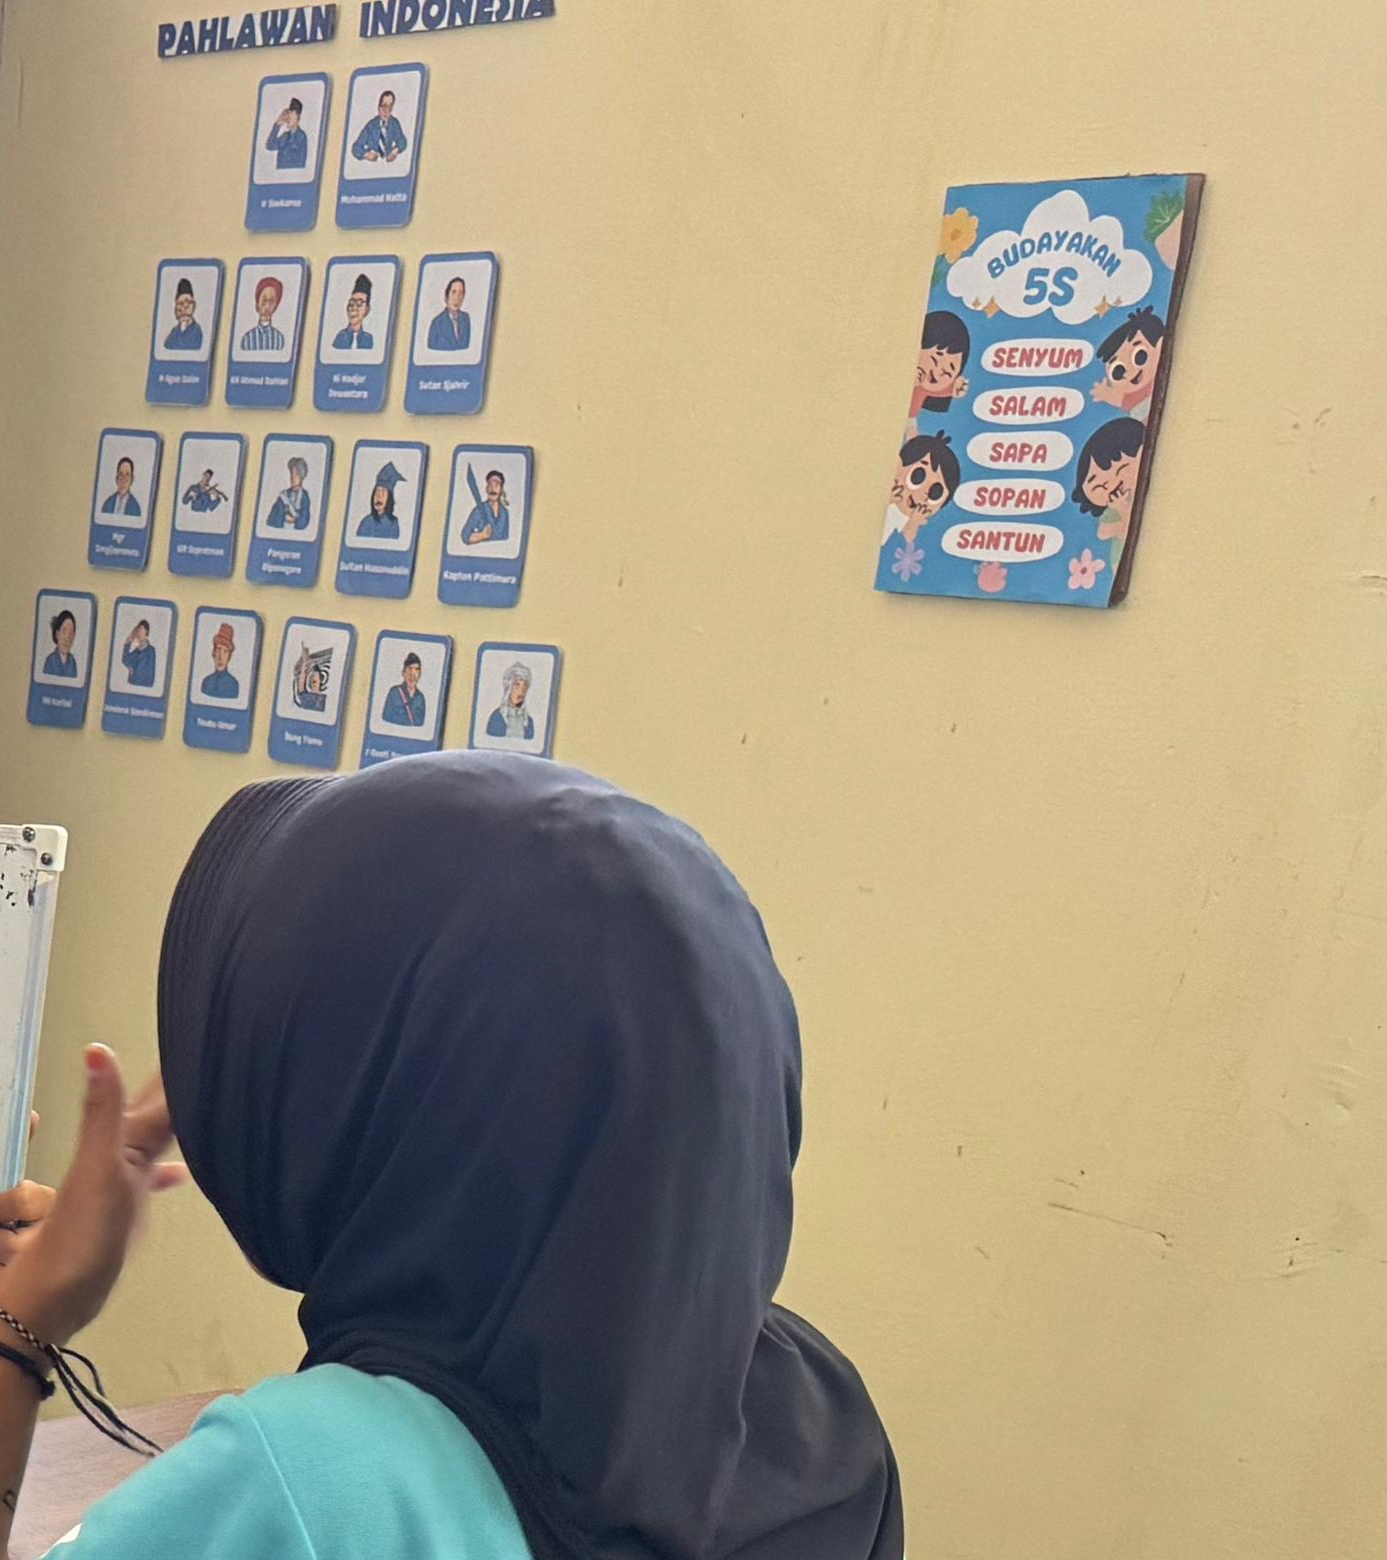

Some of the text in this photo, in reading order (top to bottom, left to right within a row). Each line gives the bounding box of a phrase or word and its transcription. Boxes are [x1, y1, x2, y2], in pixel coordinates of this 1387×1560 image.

[158, 0, 555, 57] PAHLAWAN INDONESIA
[987, 230, 1121, 279] BUDAYAKAN
[1023, 266, 1079, 307] 5S
[992, 347, 1083, 369] SENYUM
[989, 395, 1067, 417] SALAM
[989, 442, 1047, 463] SAPA
[973, 487, 1046, 509] SOPAN
[956, 529, 1045, 553] SANTUN
